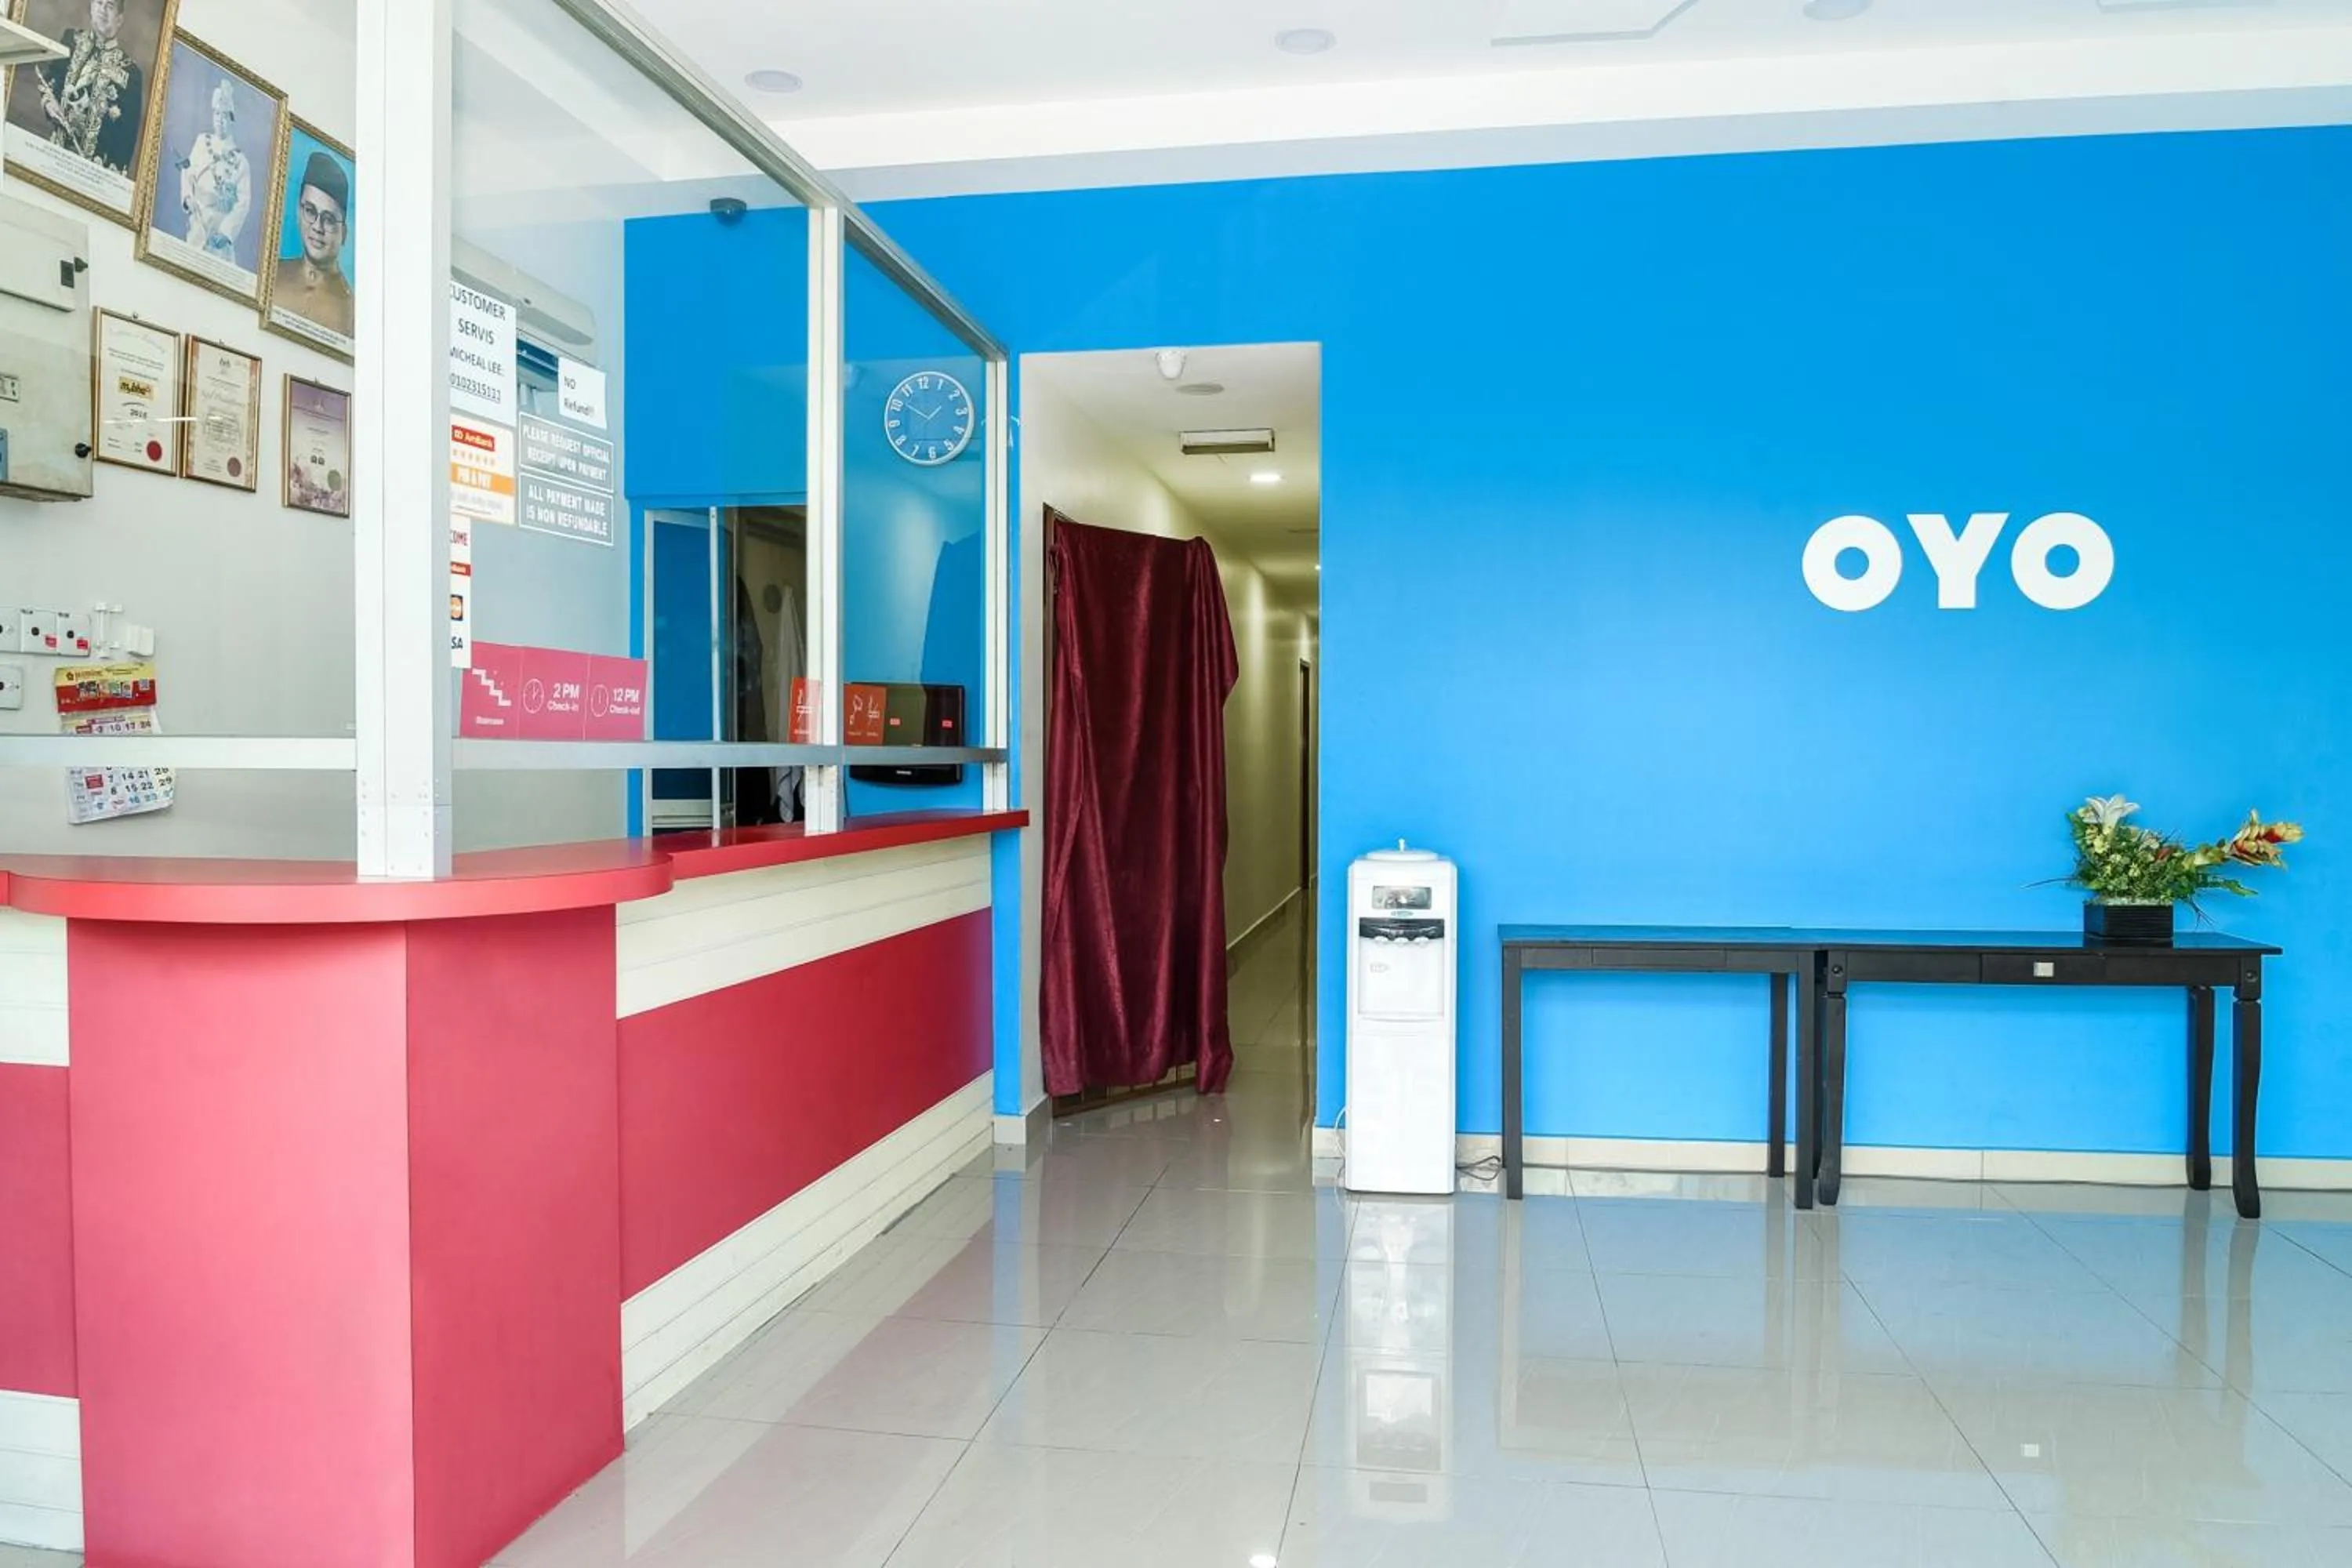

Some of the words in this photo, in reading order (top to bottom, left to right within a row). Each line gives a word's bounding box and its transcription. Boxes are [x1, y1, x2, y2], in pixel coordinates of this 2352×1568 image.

[458, 318, 495, 345] SERVIS
[916, 376, 929, 390] 12
[528, 484, 543, 502] ALL
[546, 489, 582, 510] PAYMENT
[584, 498, 605, 517] MADE
[557, 511, 608, 536] REFUNDABLE
[1802, 511, 2115, 612] OYO
[553, 683, 561, 699] 2
[562, 684, 580, 699] PM
[613, 688, 623, 702] 12
